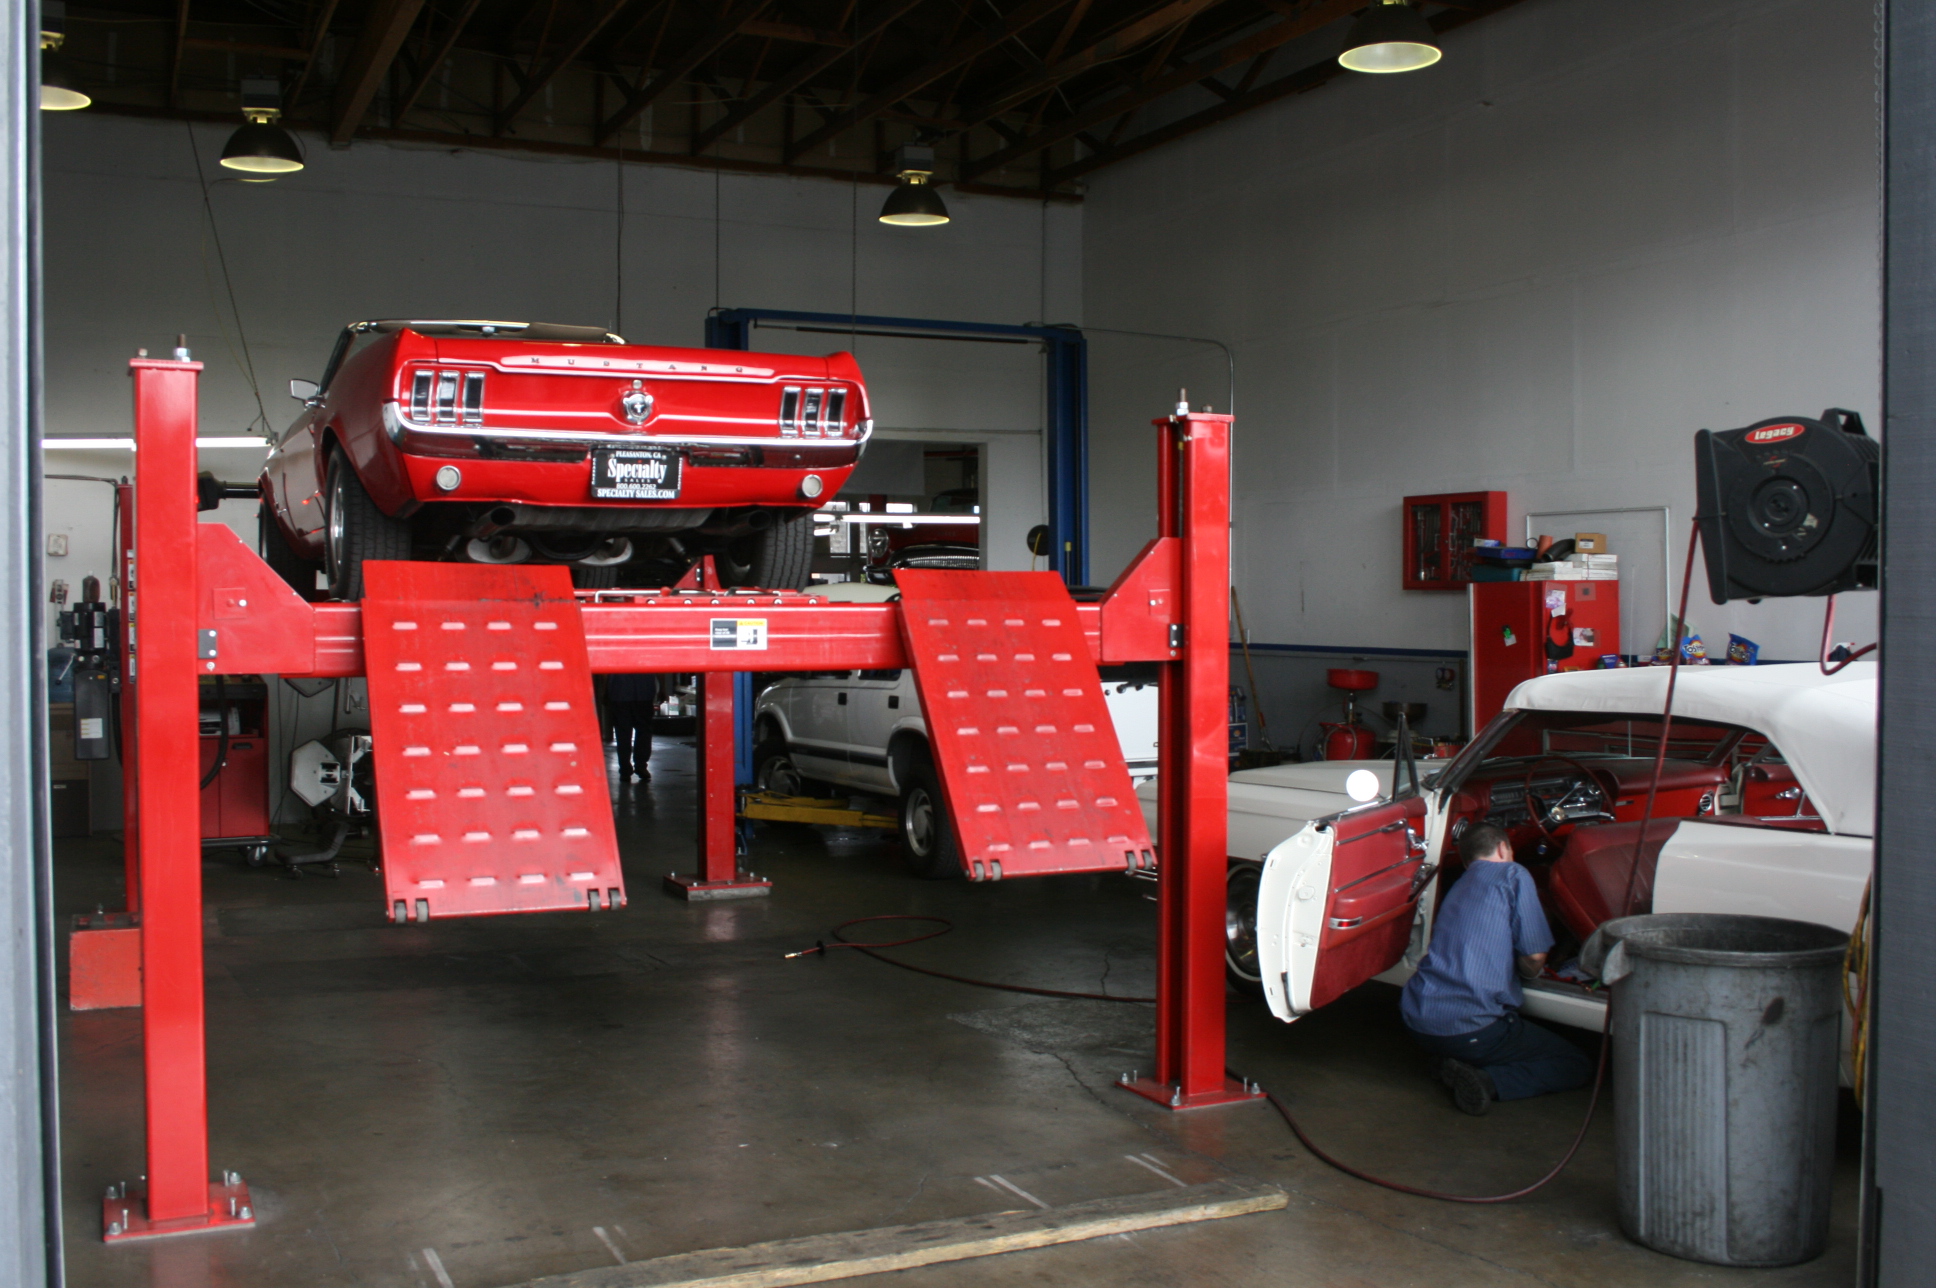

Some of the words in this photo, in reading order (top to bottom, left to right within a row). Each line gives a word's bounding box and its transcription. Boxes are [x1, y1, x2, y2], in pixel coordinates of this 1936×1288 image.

[531, 357, 743, 373] MUSTANG
[1754, 426, 1795, 441] Legacy
[608, 459, 667, 483] Specialty
